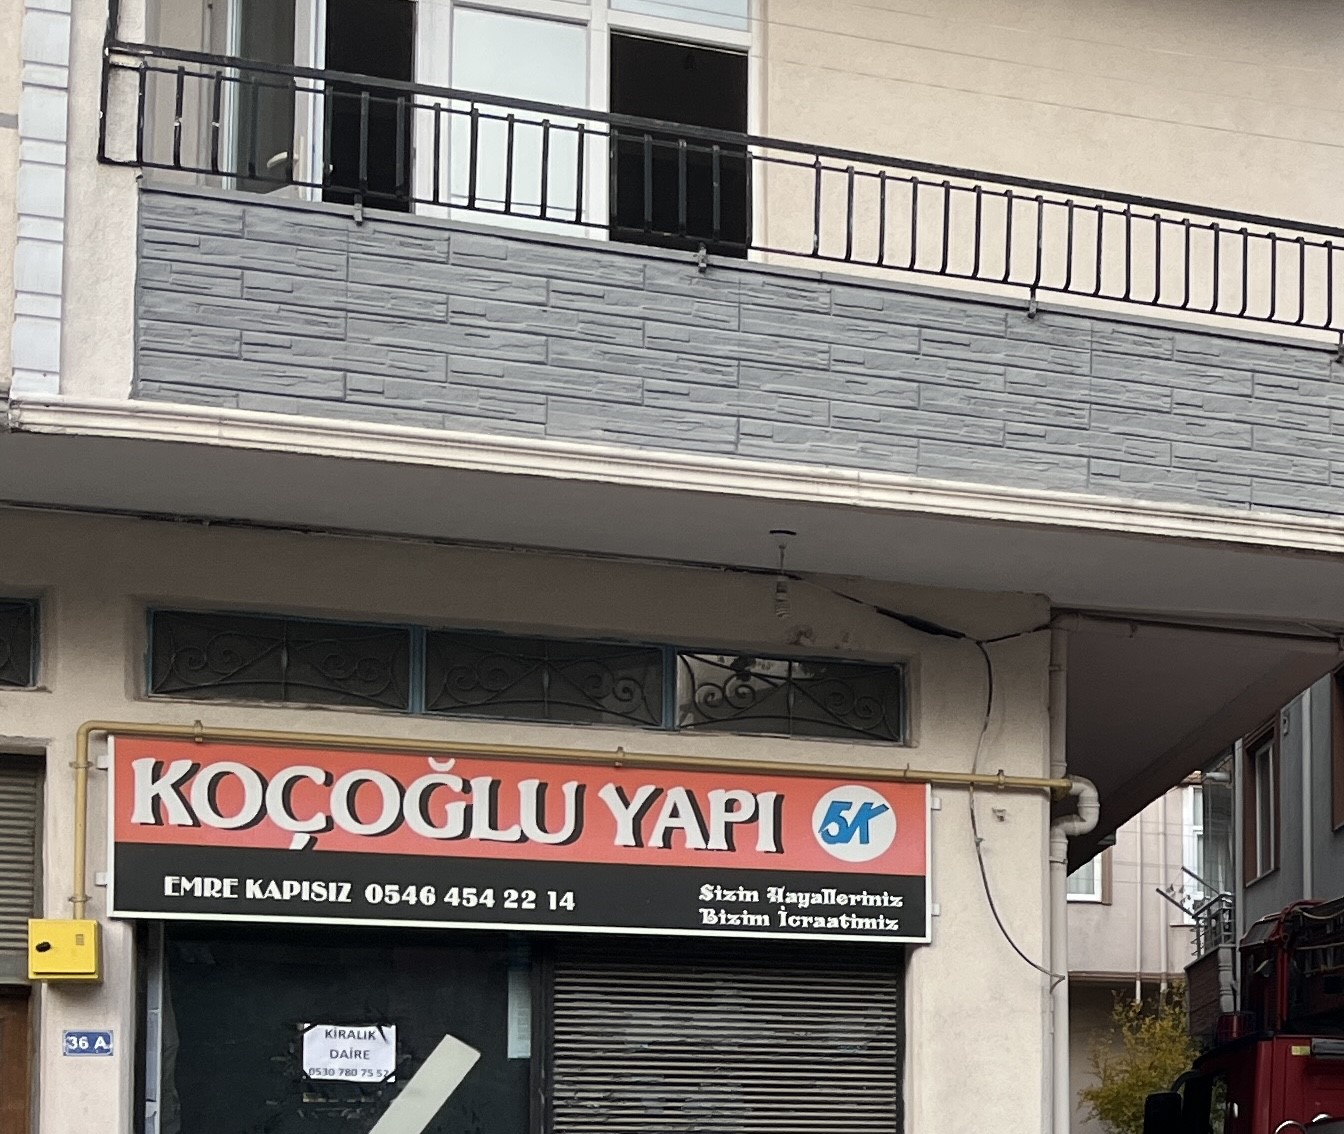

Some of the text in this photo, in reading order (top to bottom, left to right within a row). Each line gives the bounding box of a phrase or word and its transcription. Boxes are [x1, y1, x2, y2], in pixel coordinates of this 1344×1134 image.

[131, 757, 779, 852] KOÇOĞLU YAPI
[164, 876, 576, 911] EMRE KAPISIZ 0546 454 22 14
[699, 884, 903, 908] Sizin Hayalleriniz
[699, 906, 899, 931] Bizim İcraatimiz
[66, 1036, 108, 1050] 36 A
[325, 1027, 376, 1040] KİRALIK
[329, 1047, 370, 1060] DAİRE
[309, 1067, 335, 1077] 0530
[339, 1068, 358, 1077] 780
[361, 1069, 374, 1077] 75
